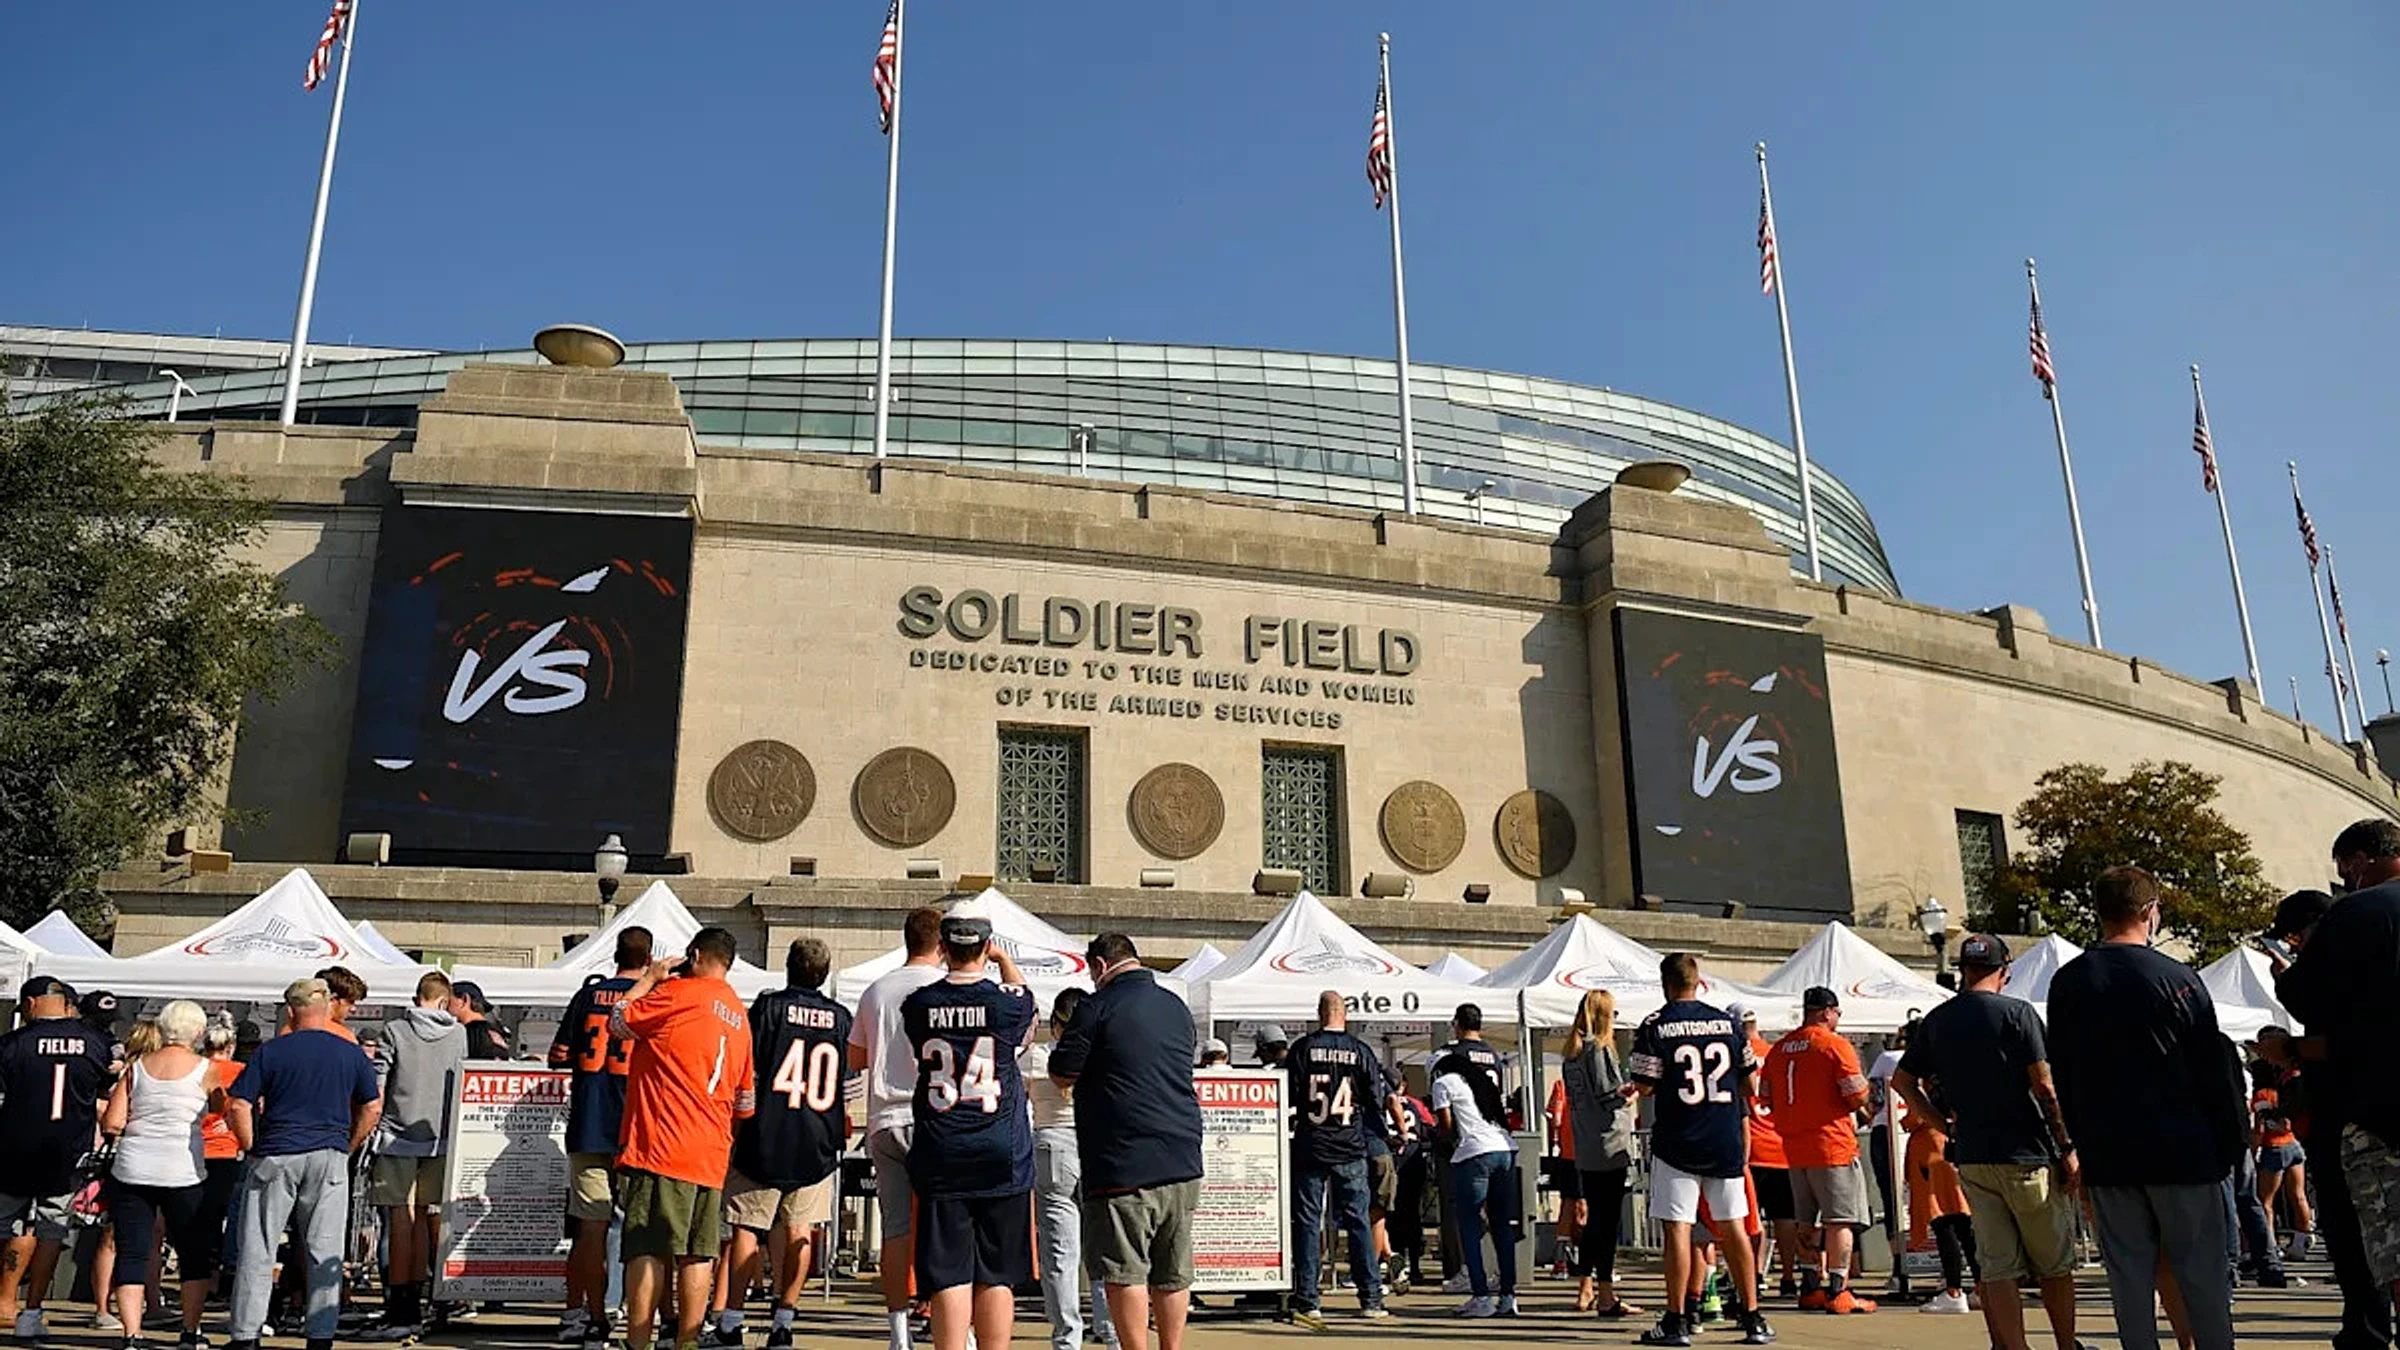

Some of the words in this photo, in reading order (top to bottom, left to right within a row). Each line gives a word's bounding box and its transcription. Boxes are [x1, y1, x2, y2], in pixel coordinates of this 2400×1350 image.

[897, 585, 1204, 659] SOLDIER
[1244, 614, 1421, 677] FIELD
[443, 619, 591, 723] VS
[909, 648, 1072, 677] DEDICATED
[1082, 660, 1119, 681] TO
[1130, 664, 1182, 686] THE
[1193, 670, 1249, 691] MEN
[1260, 675, 1312, 697] AND
[1321, 680, 1415, 706] WOMEN
[996, 686, 1033, 707] OF
[1042, 688, 1097, 711] THE
[1108, 694, 1203, 719] ARMED
[1215, 703, 1343, 729] SERVICES
[1692, 714, 1781, 798] VS
[788, 1005, 834, 1029] SAYERS
[928, 1006, 986, 1028] PAYTON
[1343, 990, 1391, 1013] ate
[1403, 991, 1419, 1013] 0
[37, 1037, 85, 1056] FIELDS
[707, 1035, 726, 1096] 1
[1674, 1042, 1733, 1105] 32
[49, 1063, 66, 1121] 1
[465, 1075, 572, 1095] ATTENTI
[772, 1038, 839, 1112] 40
[922, 1036, 1001, 1114] 34
[1193, 1083, 1278, 1103] ENTION
[1307, 1074, 1354, 1126] 54
[1787, 1060, 1795, 1105] 1
